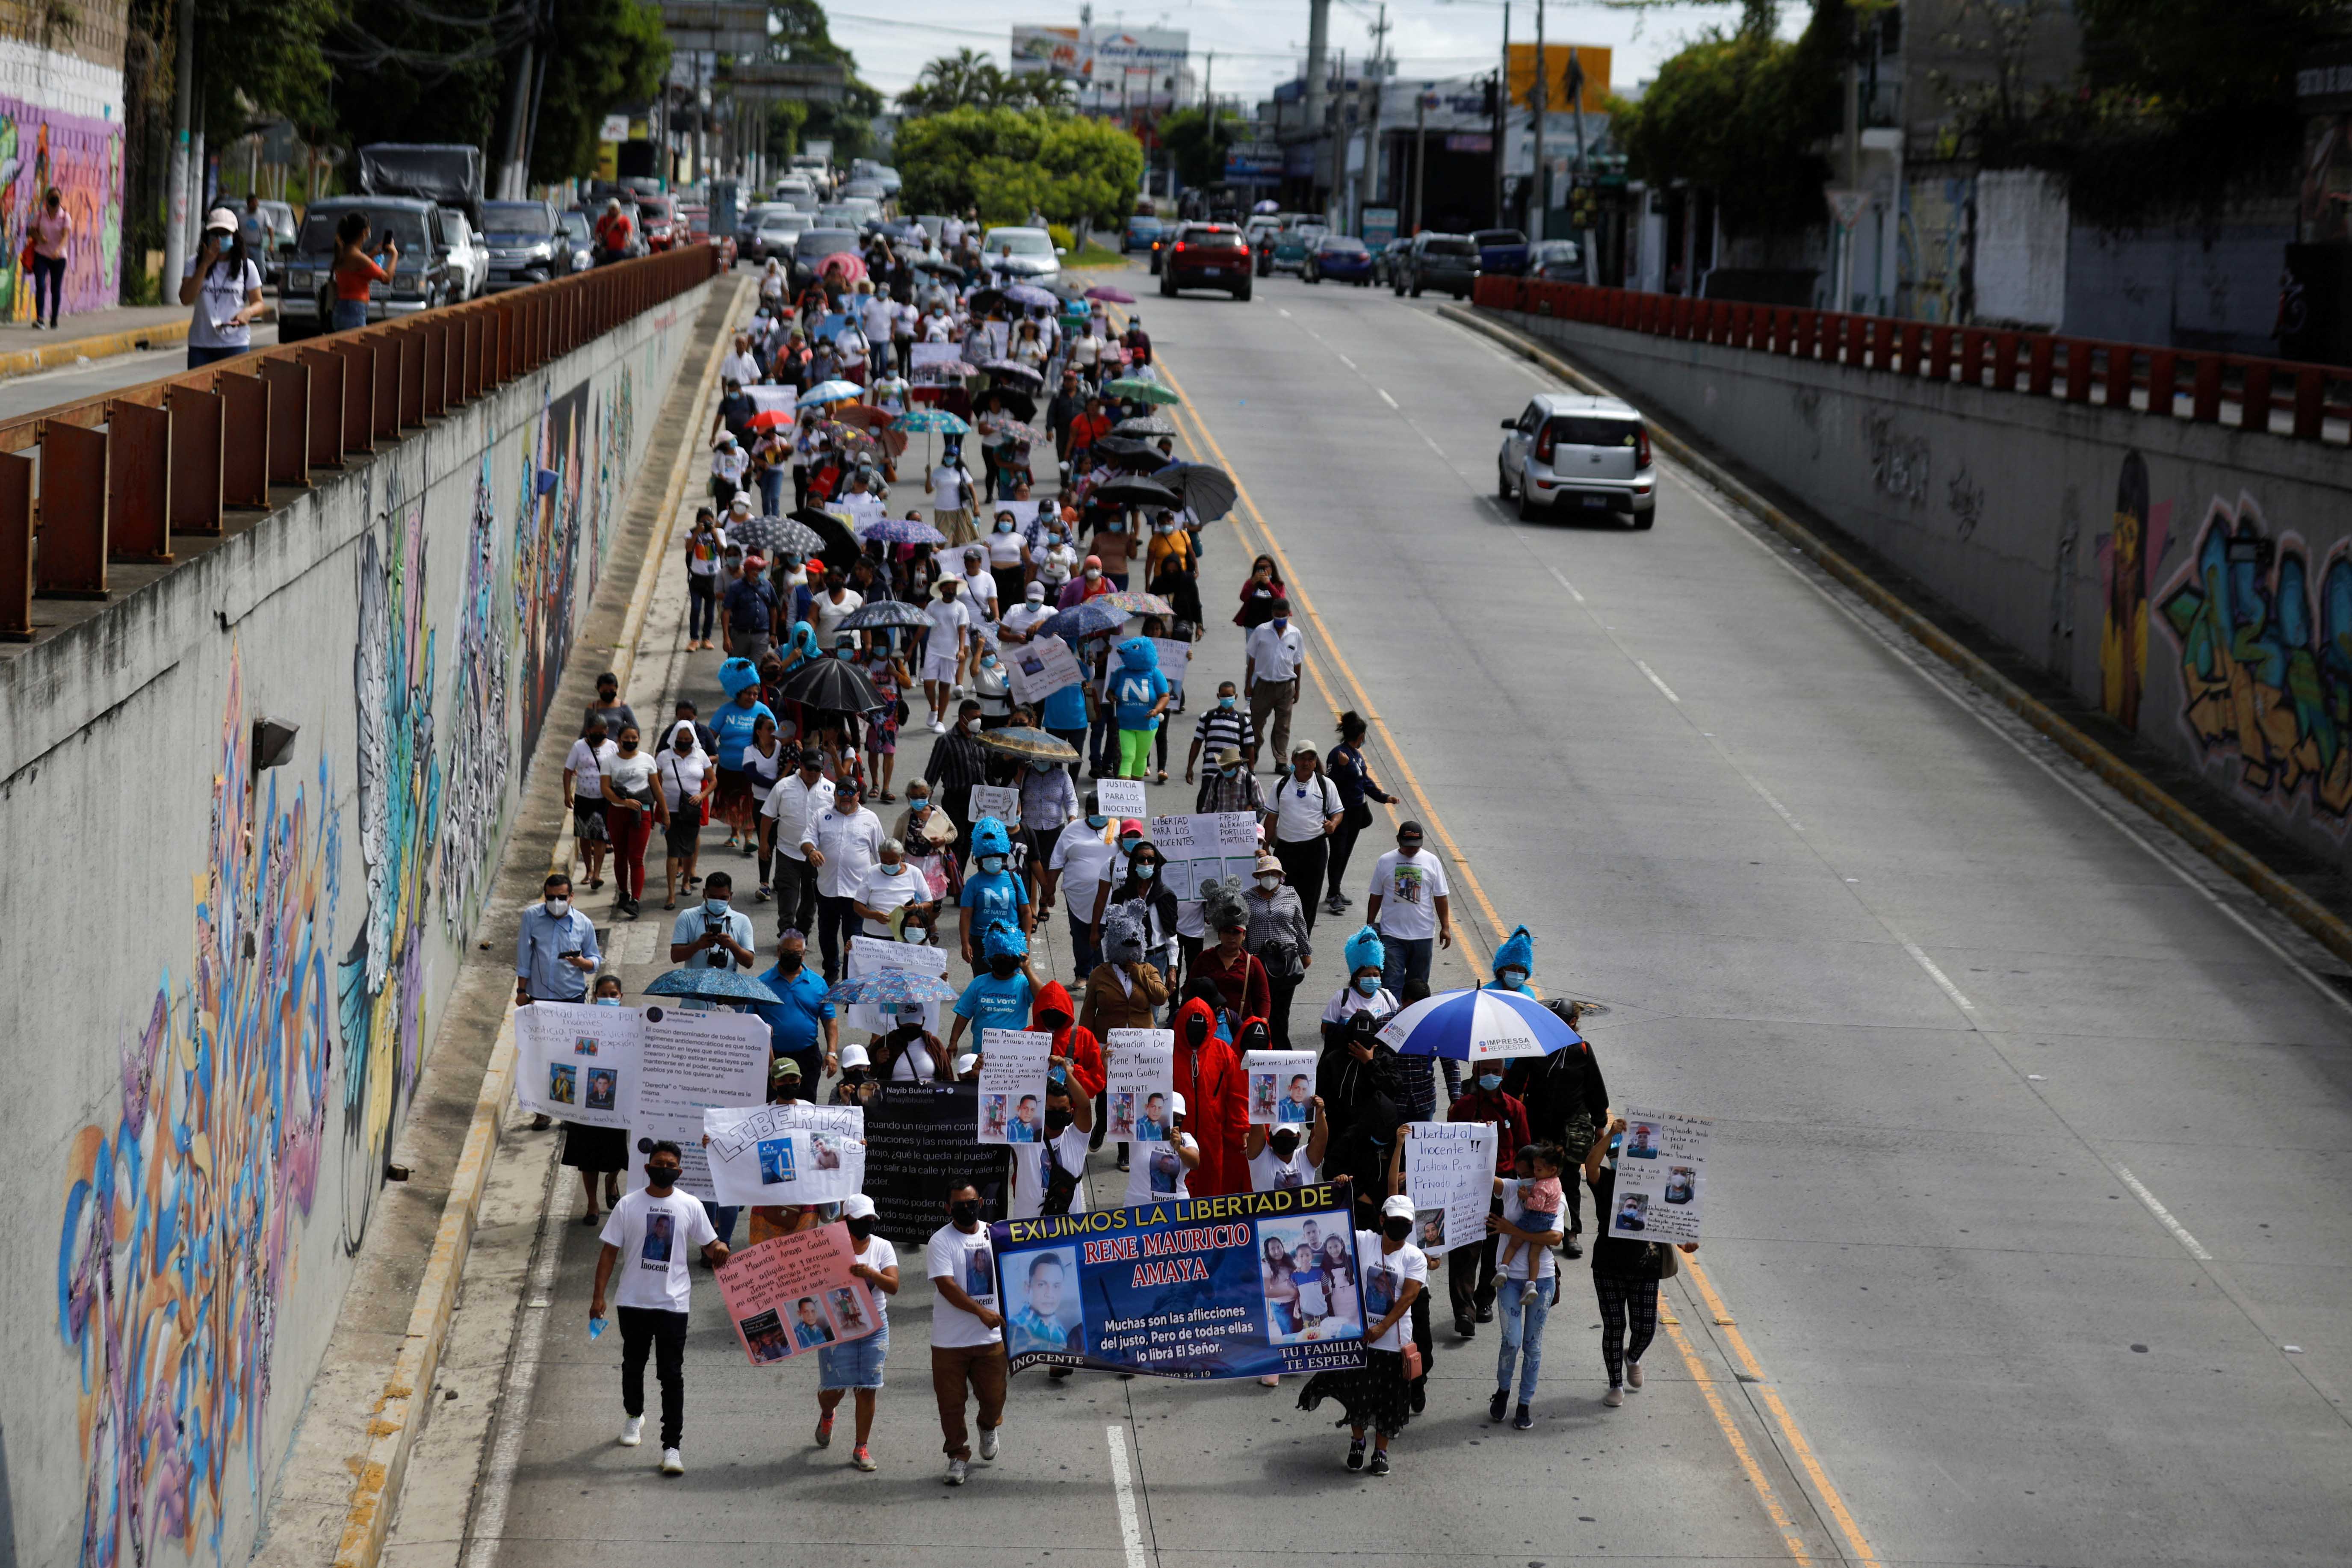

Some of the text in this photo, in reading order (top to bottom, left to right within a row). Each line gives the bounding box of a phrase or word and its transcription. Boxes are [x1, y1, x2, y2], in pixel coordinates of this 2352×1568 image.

[1122, 678, 1149, 702] N
[1103, 805, 1142, 813] INOCENTES
[1152, 816, 1188, 825] LIBERTAD
[1220, 820, 1256, 828] ALEXANDER
[1152, 827, 1171, 835] PARA
[1153, 836, 1195, 847] INOCENTES
[1221, 836, 1255, 845] MARTINES
[984, 886, 1009, 909] N
[524, 1005, 572, 1018] Libertad
[577, 1011, 596, 1022] para
[673, 1030, 710, 1038] denominador
[1002, 1030, 1027, 1038] Mauricio
[1031, 1033, 1051, 1042] Amaya
[1108, 1029, 1143, 1038] Suplicamos
[675, 1038, 724, 1048] antidemocráticos
[1110, 1040, 1145, 1048] Liberación
[1487, 1037, 1530, 1045] IMPRESSA
[1489, 1043, 1532, 1051] REPUESTOS
[1110, 1053, 1163, 1066] René Mauricio
[1250, 1058, 1265, 1067] Porque
[1108, 1068, 1160, 1080] Amaya Godoy
[886, 1087, 907, 1095] Nayib
[1117, 1084, 1149, 1093] INOCENTE
[868, 1121, 900, 1130] cuando
[916, 1123, 952, 1132] régimen
[1412, 1124, 1471, 1139] Libertad al
[1420, 1141, 1464, 1155] Inocente
[892, 1150, 912, 1159] ¿qué
[914, 1151, 921, 1159] le
[923, 1152, 952, 1161] queda
[964, 1150, 997, 1162] pueblo?
[884, 1162, 899, 1172] salir
[909, 1165, 916, 1173] la
[918, 1166, 938, 1175] calle
[948, 1166, 973, 1175] hacer
[1414, 1157, 1487, 1172] Justicia Para el
[1415, 1174, 1466, 1190] Privado de
[1412, 1192, 1446, 1207] Libertad
[1009, 1185, 1333, 1242] EXIJIMOS LA LIBERTAD DE
[761, 1243, 771, 1252] La
[774, 1233, 807, 1248] Liberación
[813, 1228, 824, 1238] De
[1083, 1223, 1250, 1264] RENE MAURICIO
[641, 1259, 670, 1273] Inocente
[720, 1237, 830, 1284] René Mauricio Amaya Godoy
[731, 1279, 754, 1293] Aunque
[759, 1263, 786, 1281] afligido
[1132, 1257, 1209, 1288] AMAYA
[754, 1296, 774, 1311] Dios
[1105, 1306, 1246, 1333] Muchas son las aflicciones
[1100, 1321, 1254, 1350] del justo, Pero de todas ellas
[1136, 1341, 1223, 1362] lo librá El Señor.
[1279, 1341, 1363, 1358] TU FAMILIA
[1012, 1353, 1084, 1372] INOCENTE
[1284, 1354, 1361, 1370] TE ESPERA
